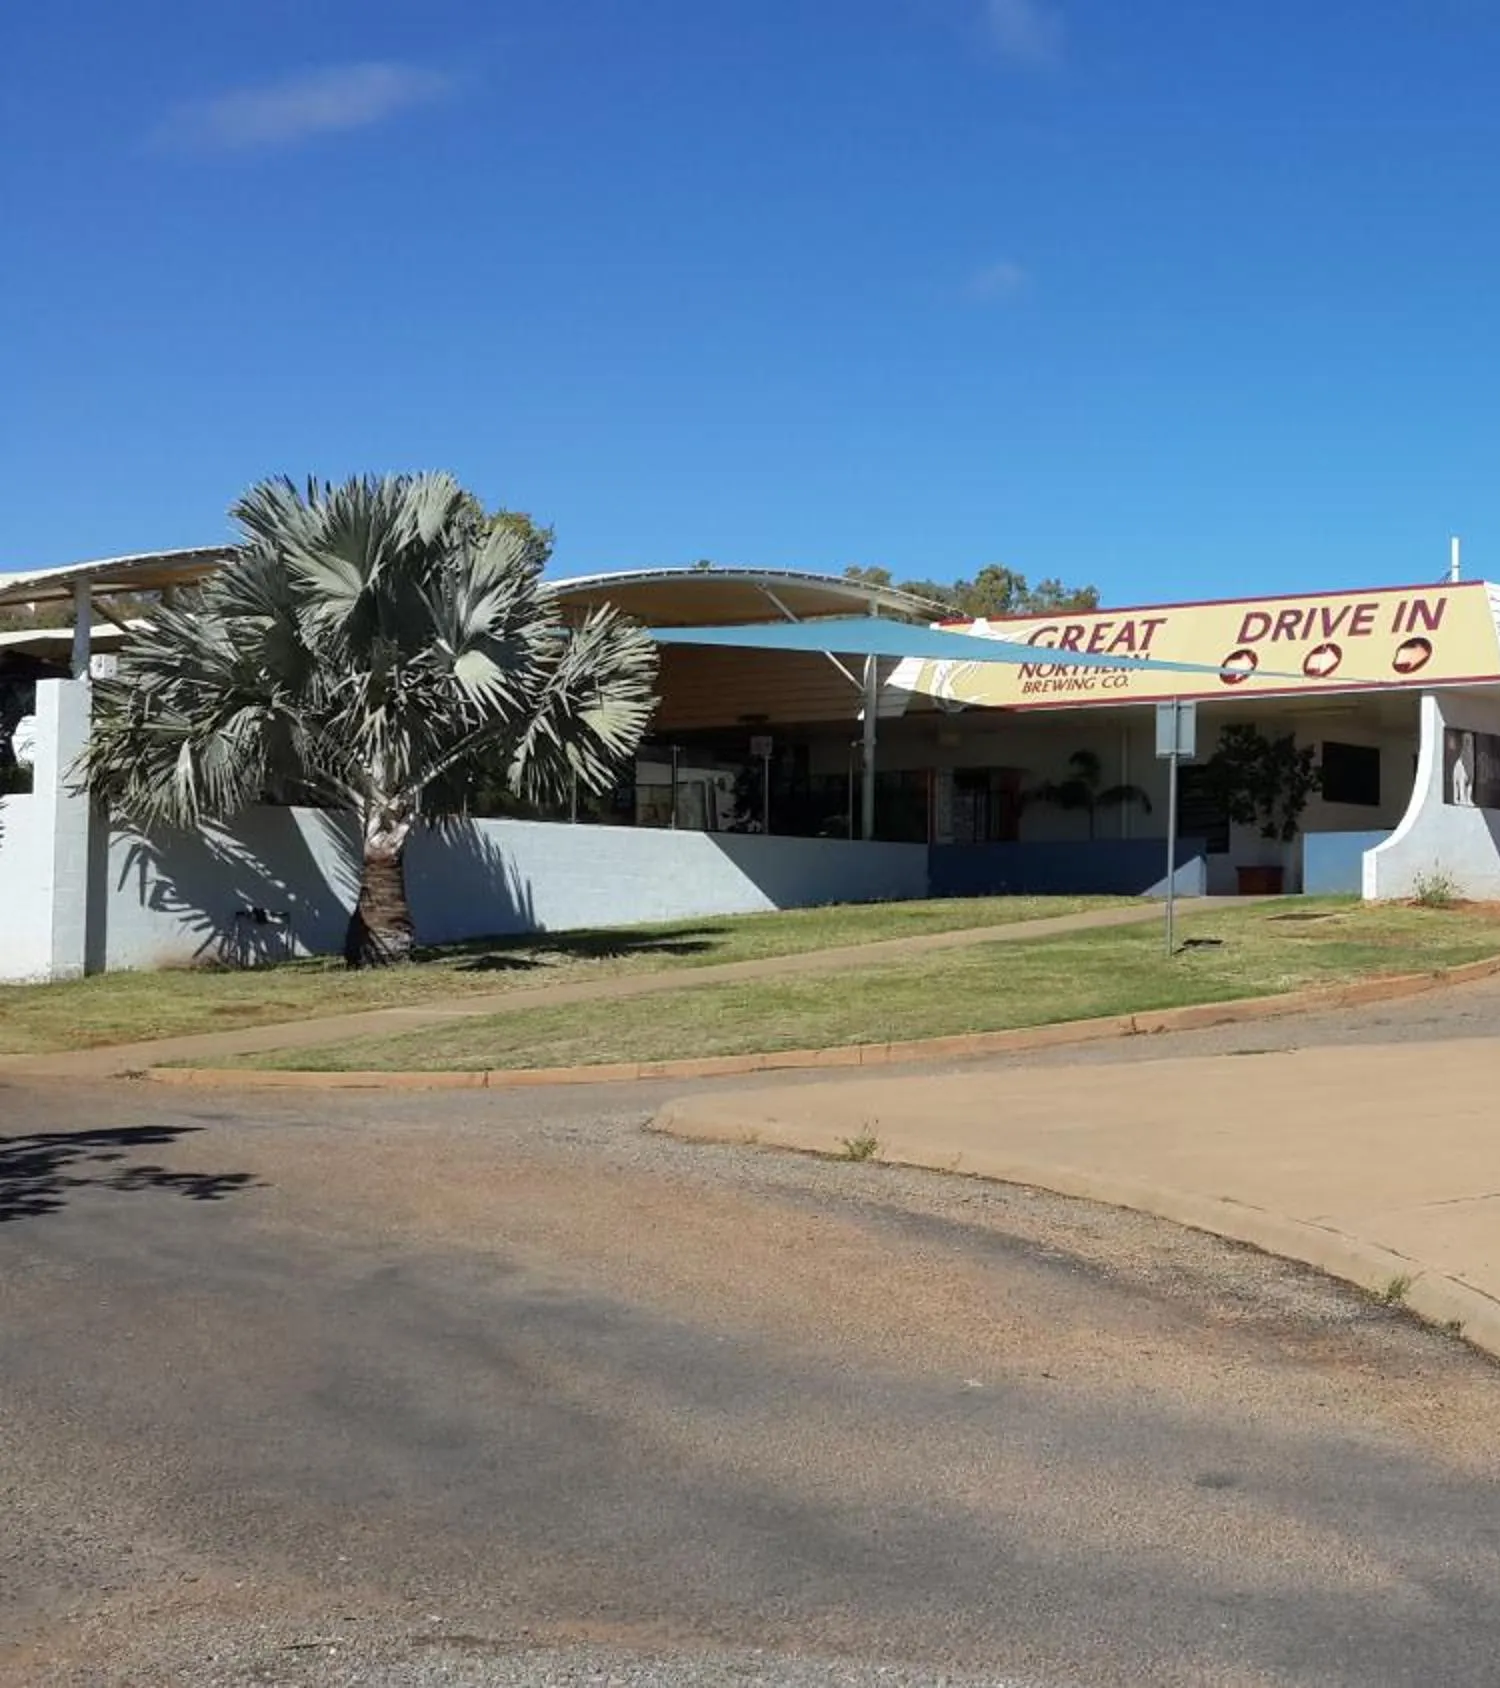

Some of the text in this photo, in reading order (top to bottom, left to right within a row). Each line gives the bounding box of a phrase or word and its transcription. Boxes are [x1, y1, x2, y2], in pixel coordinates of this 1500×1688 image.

[1027, 617, 1169, 654] GREAT
[1236, 598, 1448, 645] DRIVE IN
[1021, 674, 1129, 694] BREWING CO.
